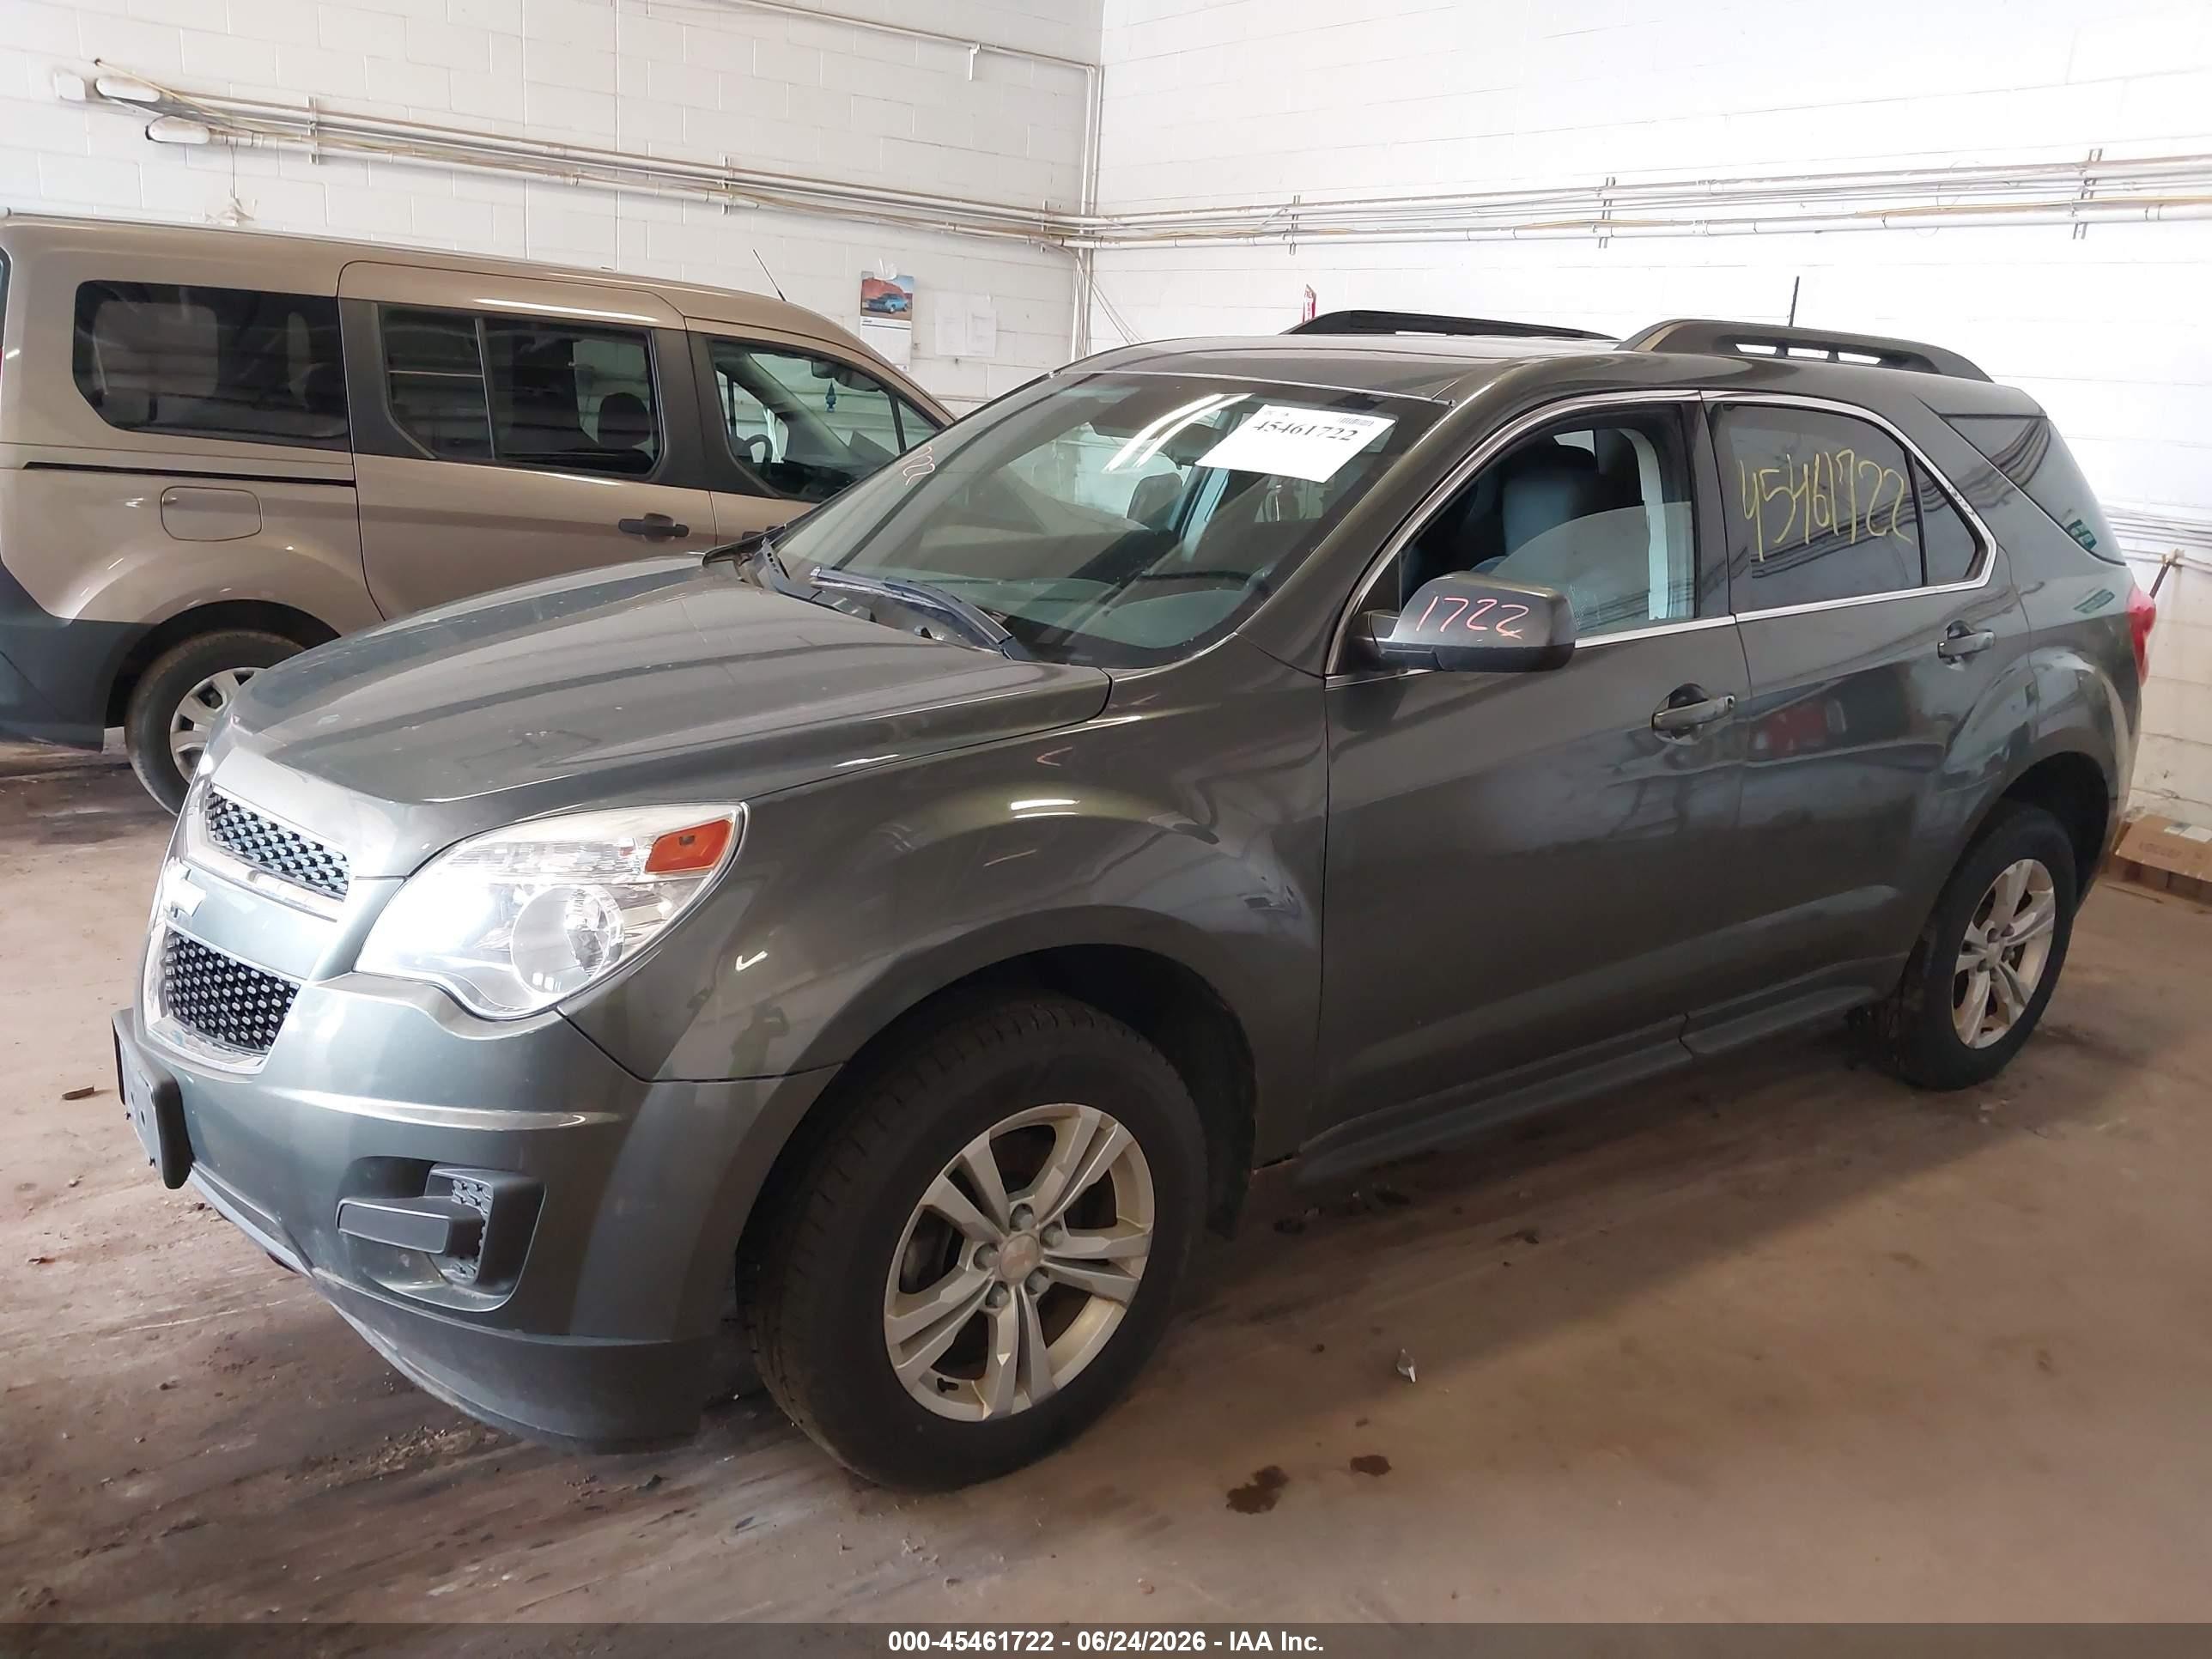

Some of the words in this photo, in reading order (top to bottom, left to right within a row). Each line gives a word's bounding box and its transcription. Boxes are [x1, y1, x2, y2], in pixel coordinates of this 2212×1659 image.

[1253, 420, 1358, 441] 45461722
[1739, 448, 1915, 563] 45461722
[1415, 595, 1529, 640] 1722
